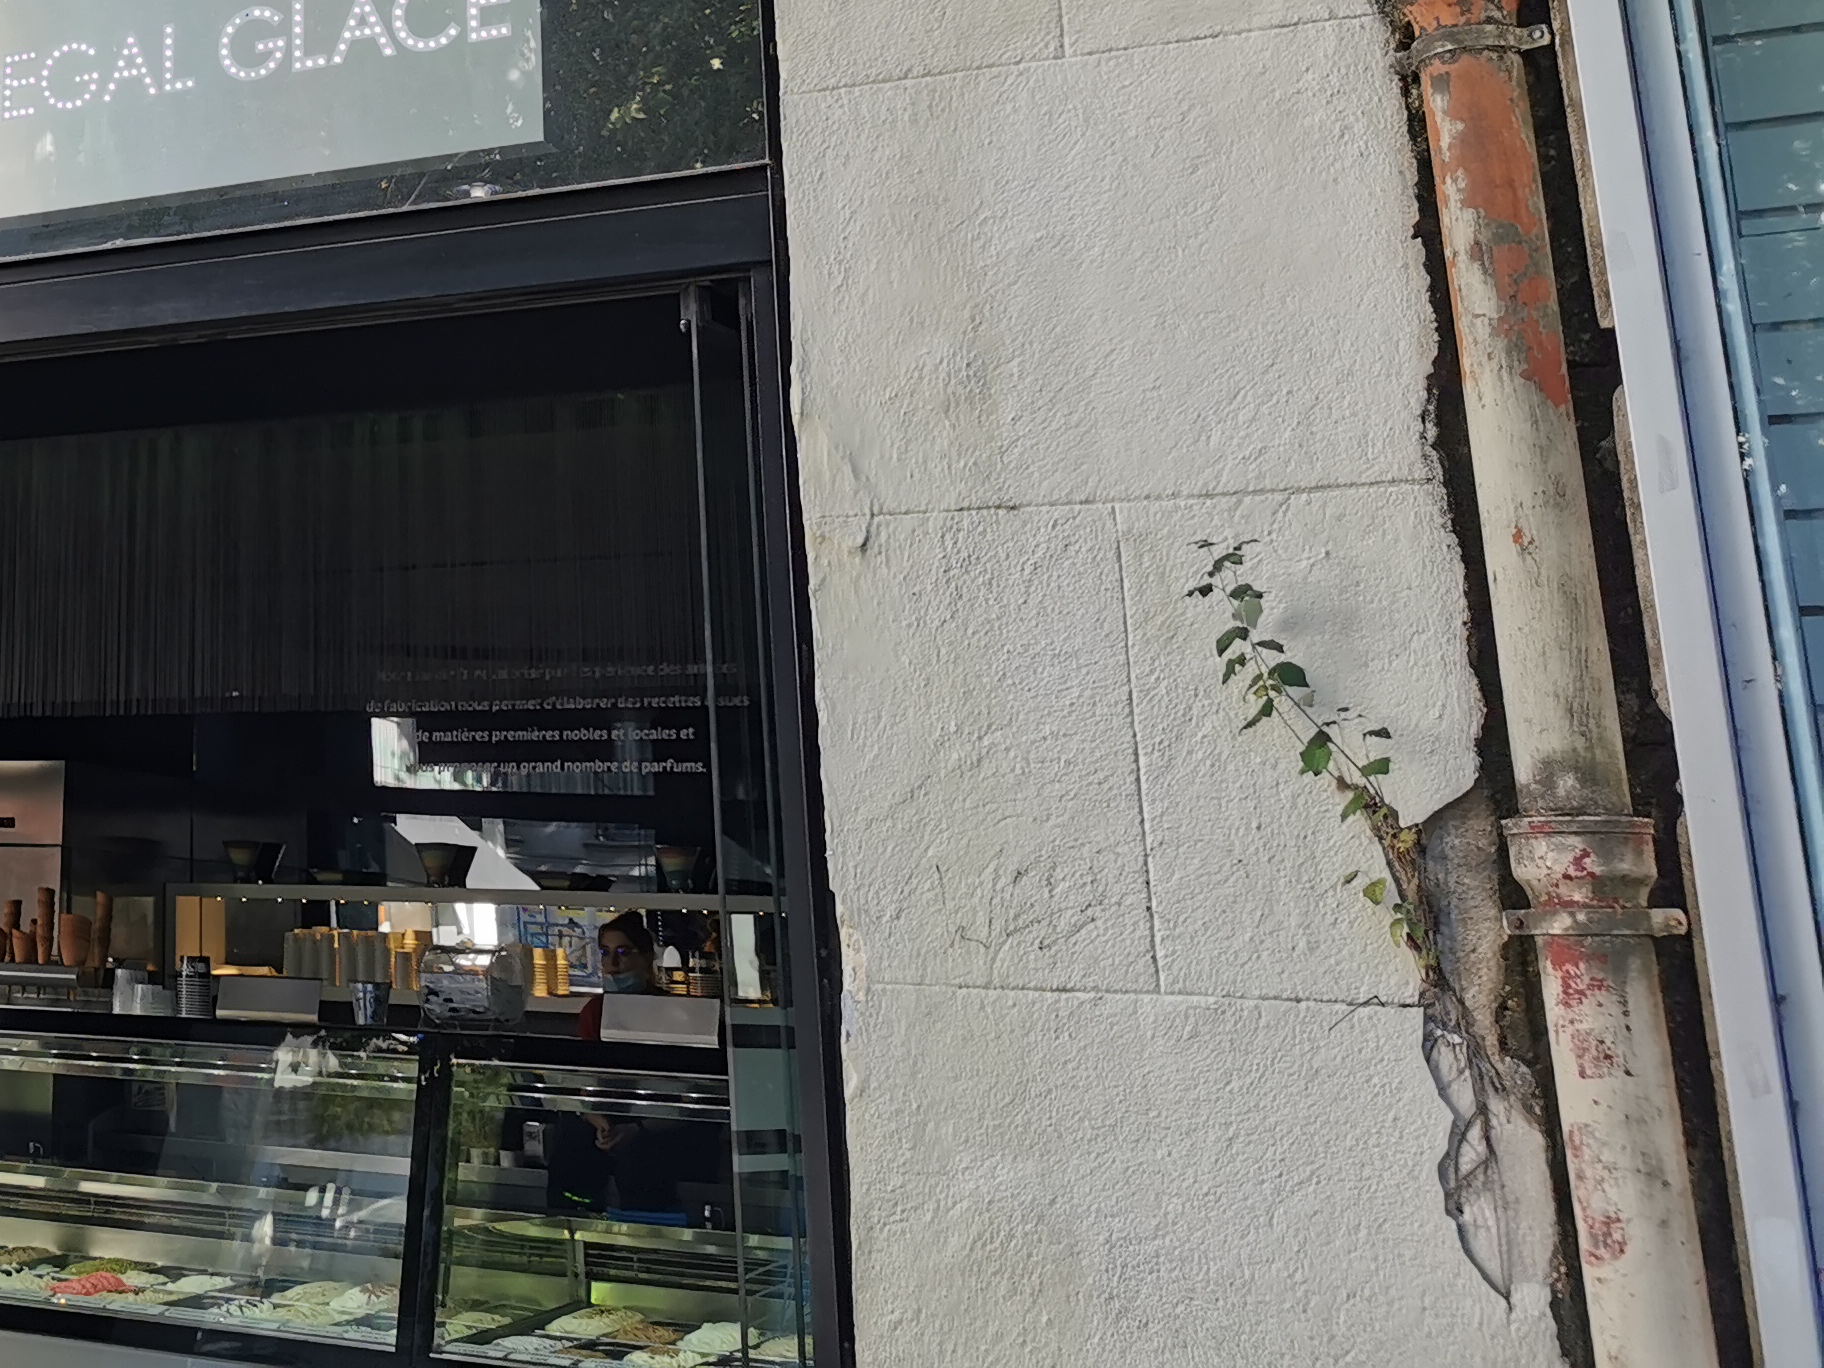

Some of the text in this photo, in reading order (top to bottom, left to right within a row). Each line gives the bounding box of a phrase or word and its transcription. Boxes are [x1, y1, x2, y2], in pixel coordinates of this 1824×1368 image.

[366, 695, 701, 713] de fabrication nous permet d'élaborer des recettes
[415, 727, 695, 743] de matières premières nobles et locales et
[499, 763, 518, 773] un
[520, 759, 561, 774] grand
[564, 759, 618, 773] nombre
[621, 759, 638, 772] de
[642, 758, 706, 775] parfums.
